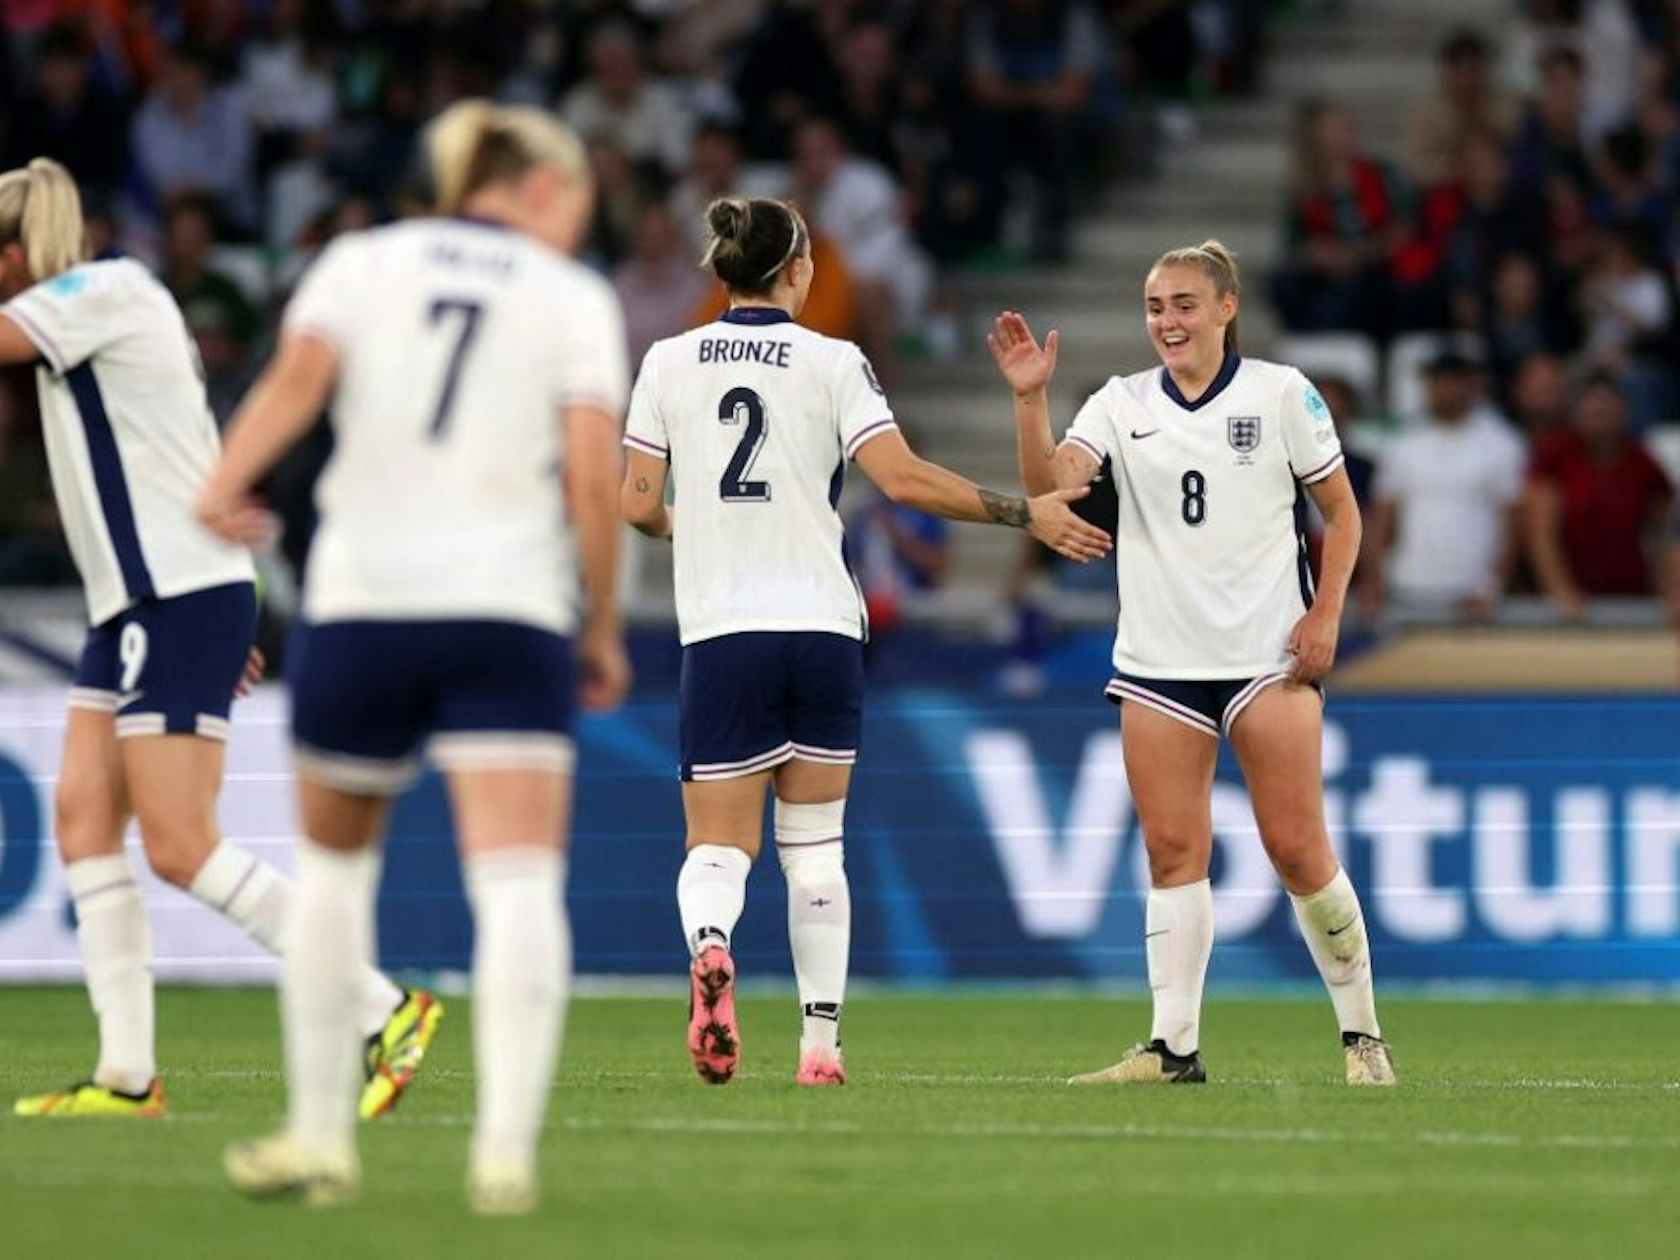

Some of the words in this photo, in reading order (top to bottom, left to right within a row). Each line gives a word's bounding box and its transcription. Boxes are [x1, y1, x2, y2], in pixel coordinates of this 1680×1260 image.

[426, 295, 487, 443] 7
[699, 338, 792, 368] BRONZE
[718, 386, 772, 502] 2
[1181, 470, 1208, 527] 8
[119, 622, 148, 690] 9
